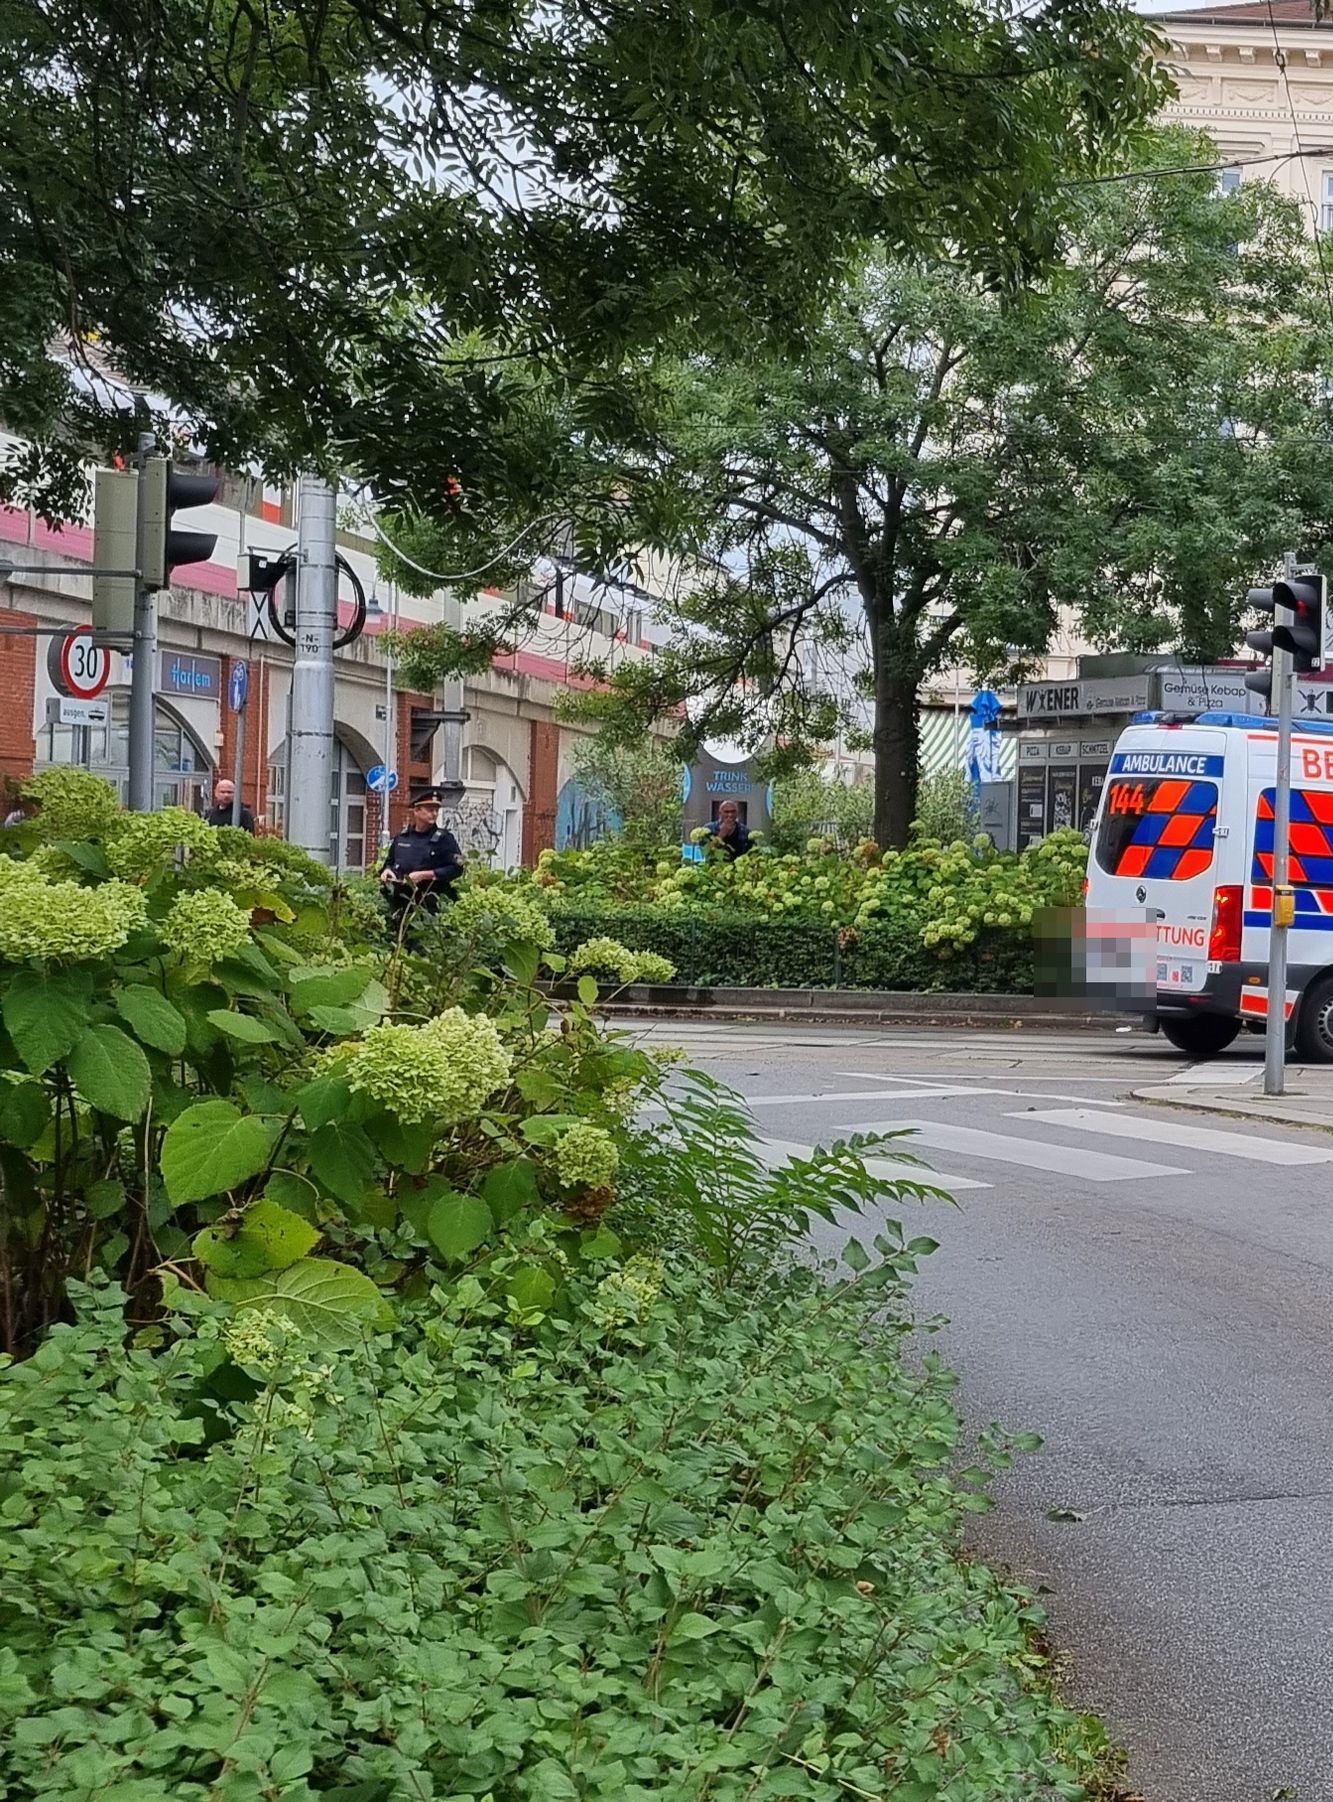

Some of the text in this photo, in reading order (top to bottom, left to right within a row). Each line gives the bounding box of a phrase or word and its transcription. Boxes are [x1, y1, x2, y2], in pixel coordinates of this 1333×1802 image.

[301, 644, 319, 654] 190
[75, 645, 98, 679] 30
[171, 656, 212, 692] Harlem
[1210, 684, 1247, 697] Kebap
[1187, 698, 1196, 706] &
[63, 709, 87, 719] ausgen.
[1122, 753, 1206, 774] AMBULANCE
[713, 770, 748, 781] TRINK
[705, 781, 753, 793] WASSER
[1109, 782, 1144, 815] 144
[1156, 925, 1205, 947] TTUNG
